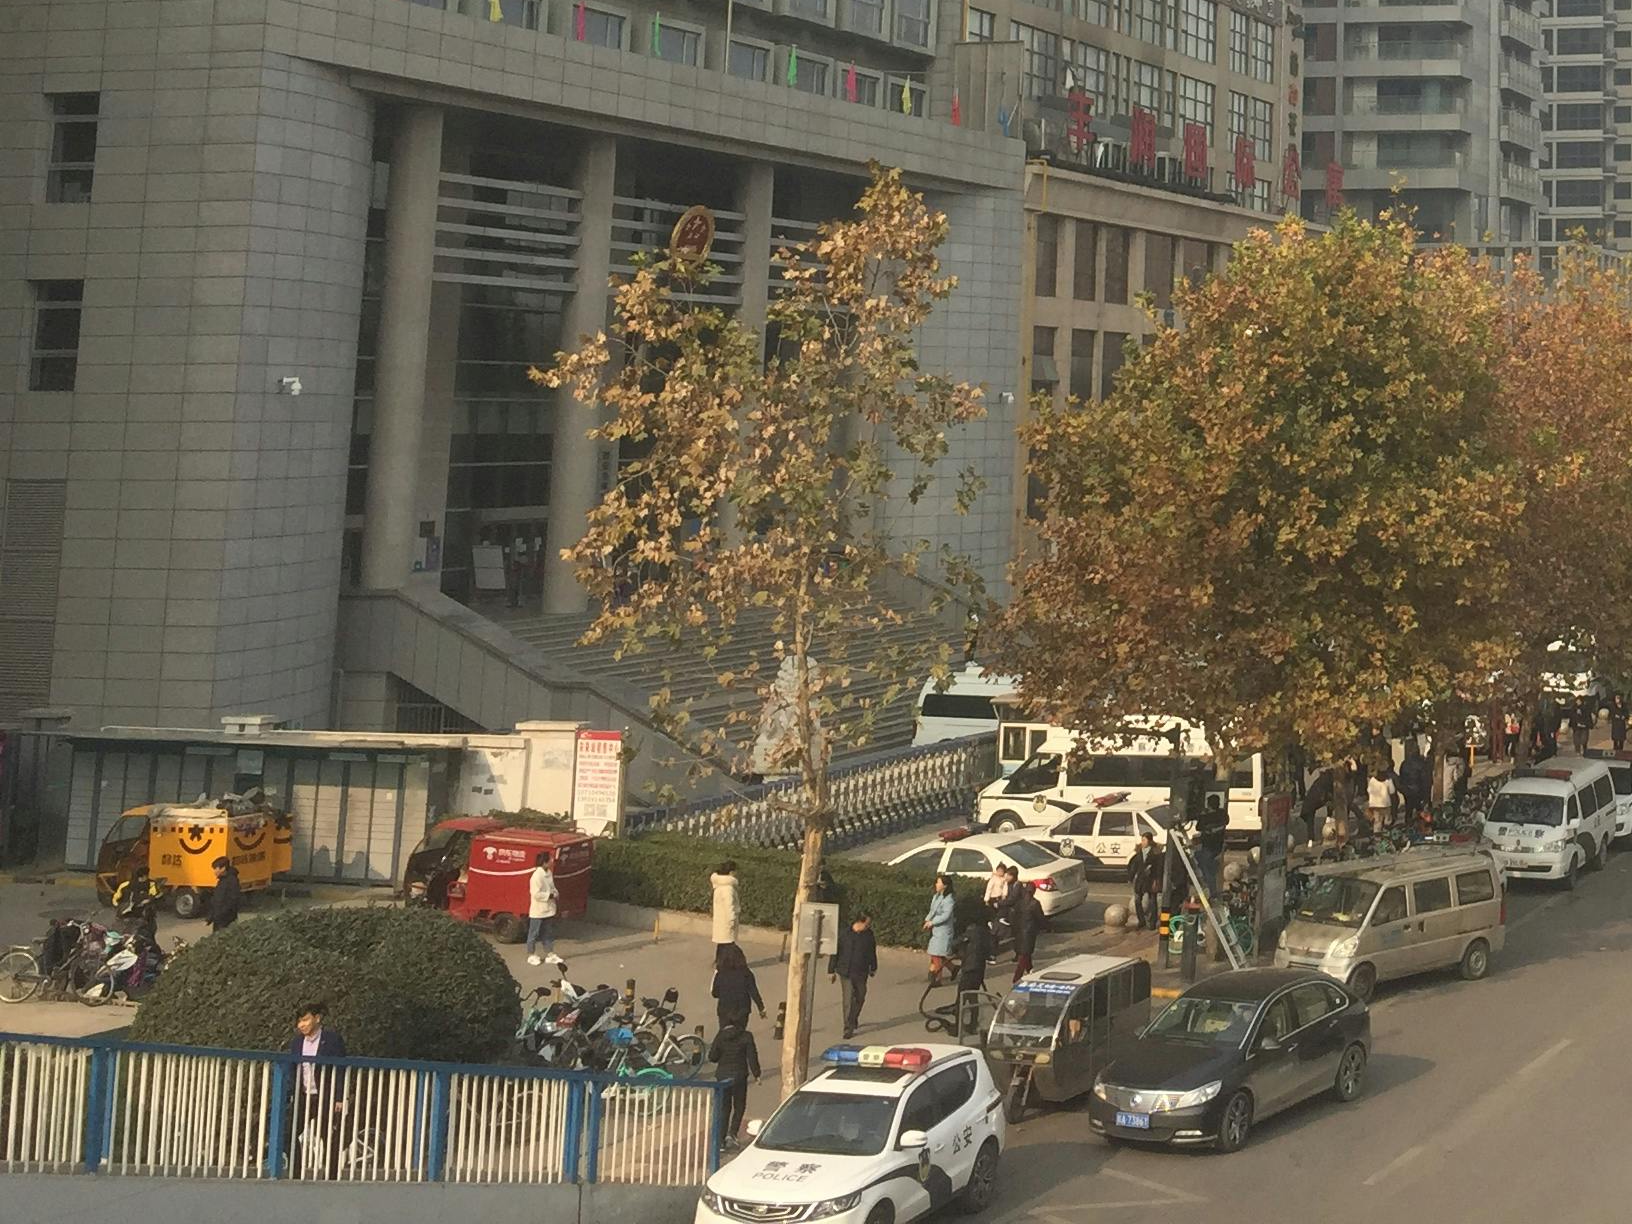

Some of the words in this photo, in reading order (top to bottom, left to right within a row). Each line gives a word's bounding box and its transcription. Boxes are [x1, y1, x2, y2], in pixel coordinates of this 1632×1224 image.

[1095, 842, 1121, 854] 公安
[952, 1124, 973, 1155] 公安
[762, 1160, 822, 1174] 警察
[751, 1172, 808, 1183] POLICE
